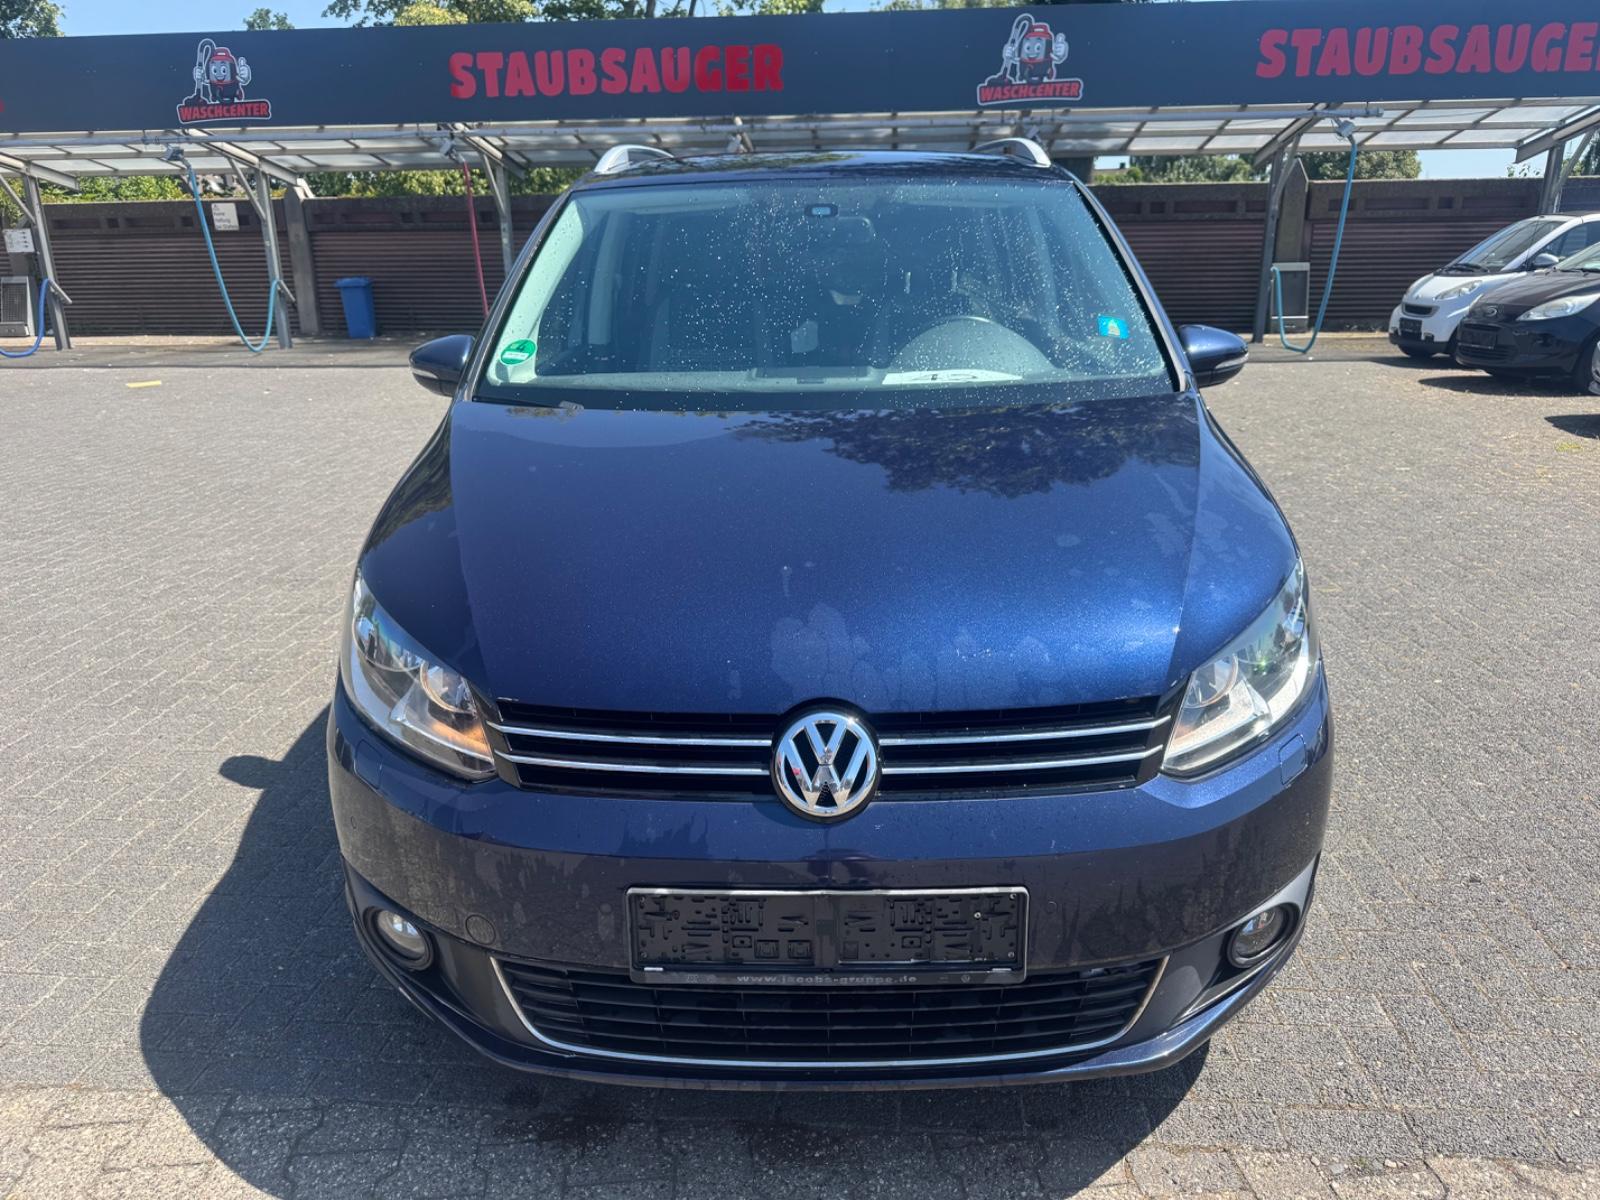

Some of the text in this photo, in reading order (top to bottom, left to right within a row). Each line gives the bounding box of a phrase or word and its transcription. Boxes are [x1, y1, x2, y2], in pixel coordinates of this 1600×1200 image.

[1256, 22, 1600, 78] STAUBSAUGE
[450, 45, 783, 99] STAUBSAUGER
[981, 83, 1078, 101] WASCHCENTER
[181, 103, 268, 121] WASCHCENTER
